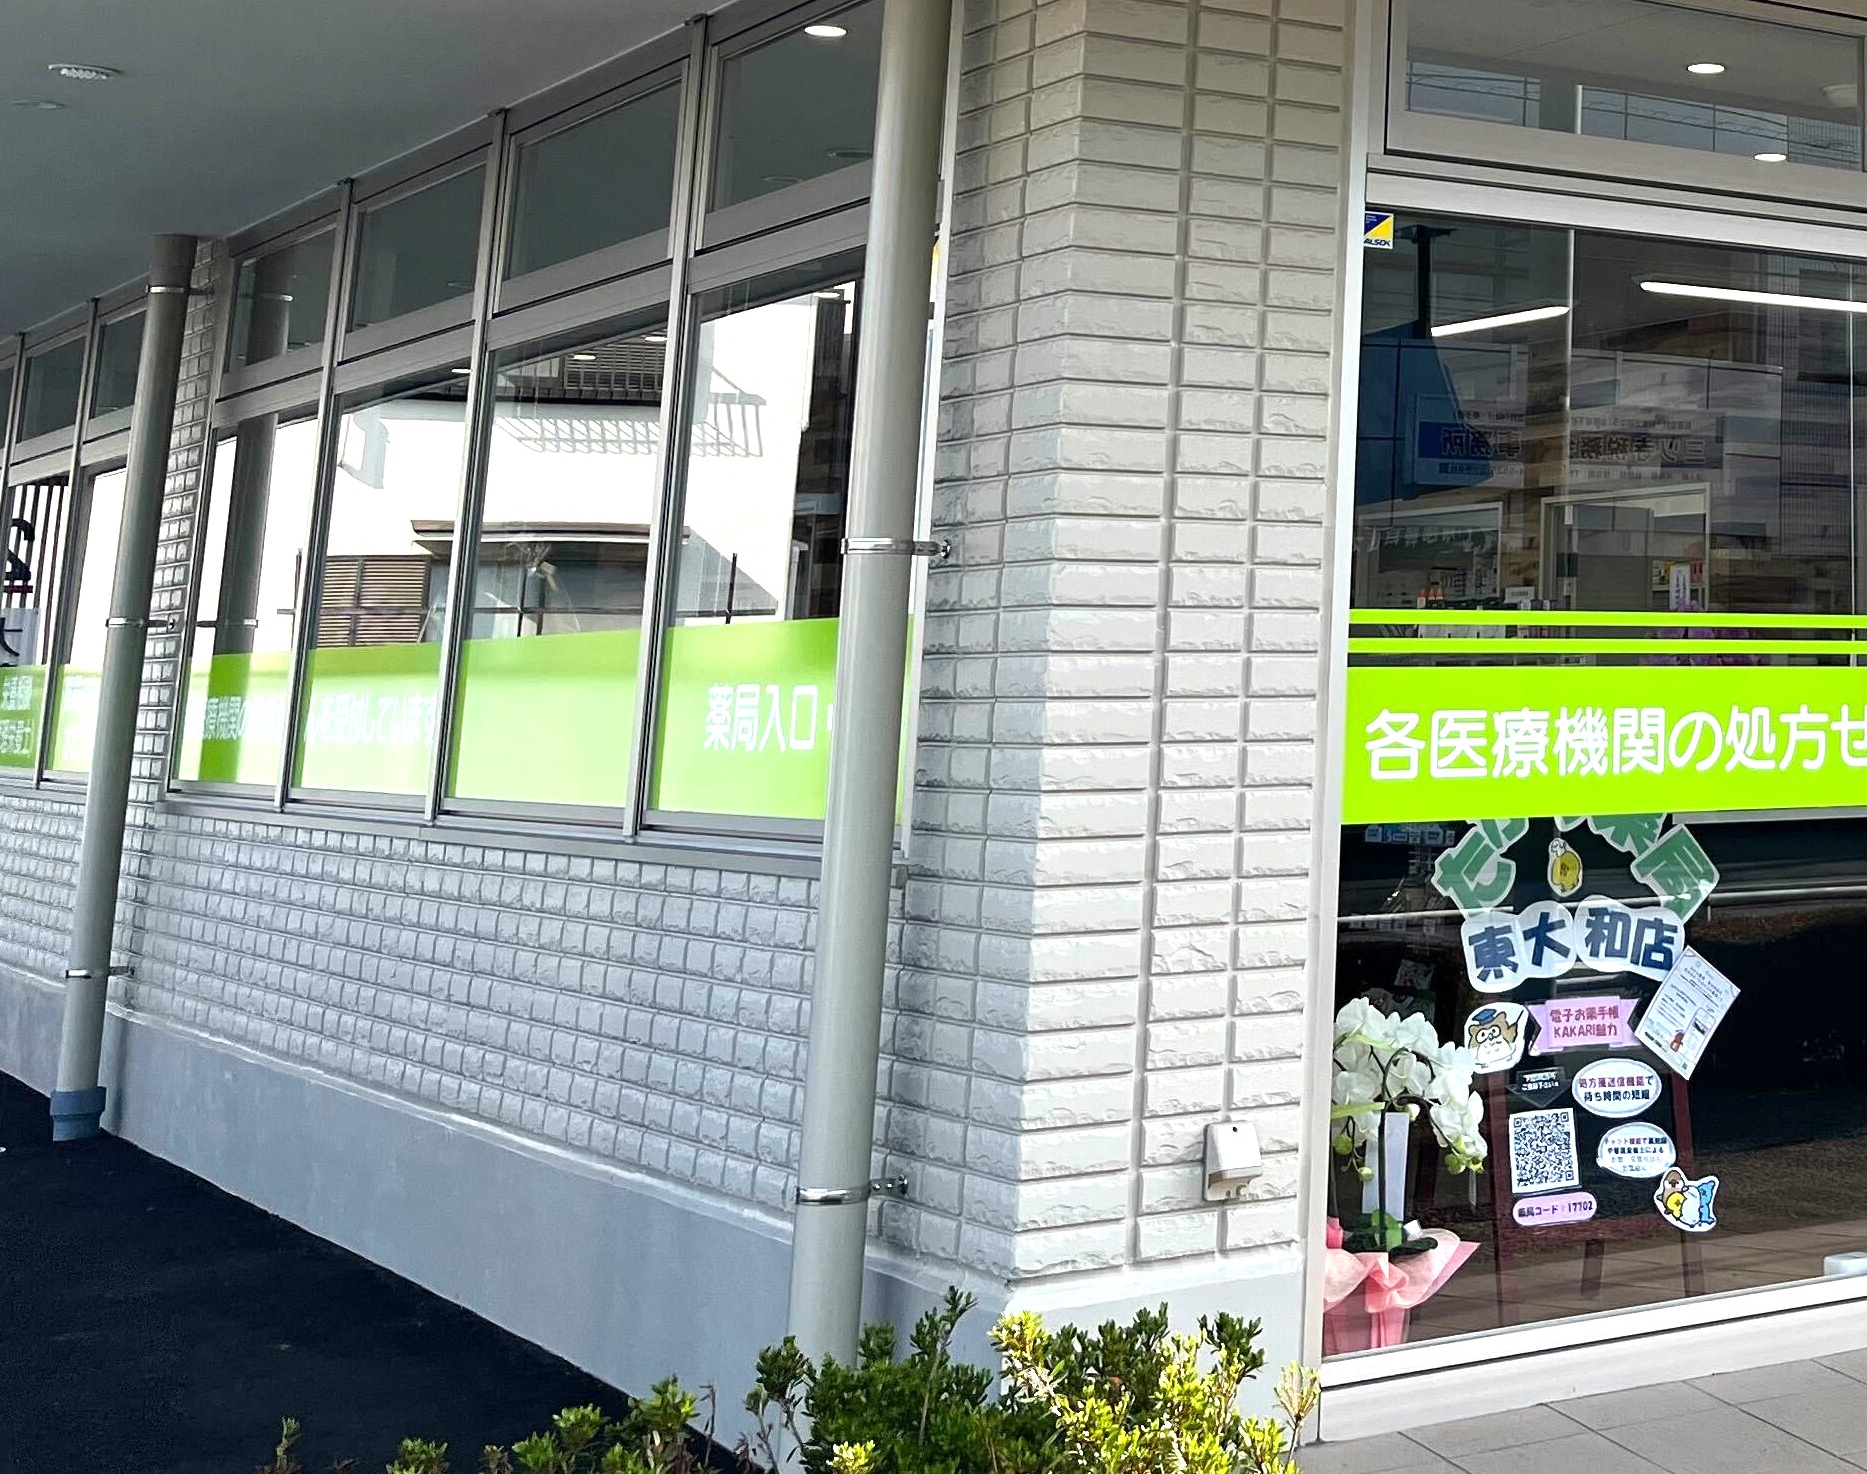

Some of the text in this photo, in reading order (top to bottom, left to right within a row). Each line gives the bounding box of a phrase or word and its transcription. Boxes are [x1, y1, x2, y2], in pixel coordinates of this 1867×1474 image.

[1364, 237, 1392, 247] ALSOK
[703, 683, 818, 752] 薬局入口
[1468, 906, 1679, 983] 東大和店
[1550, 1005, 1619, 1024] 電子お薬手帳
